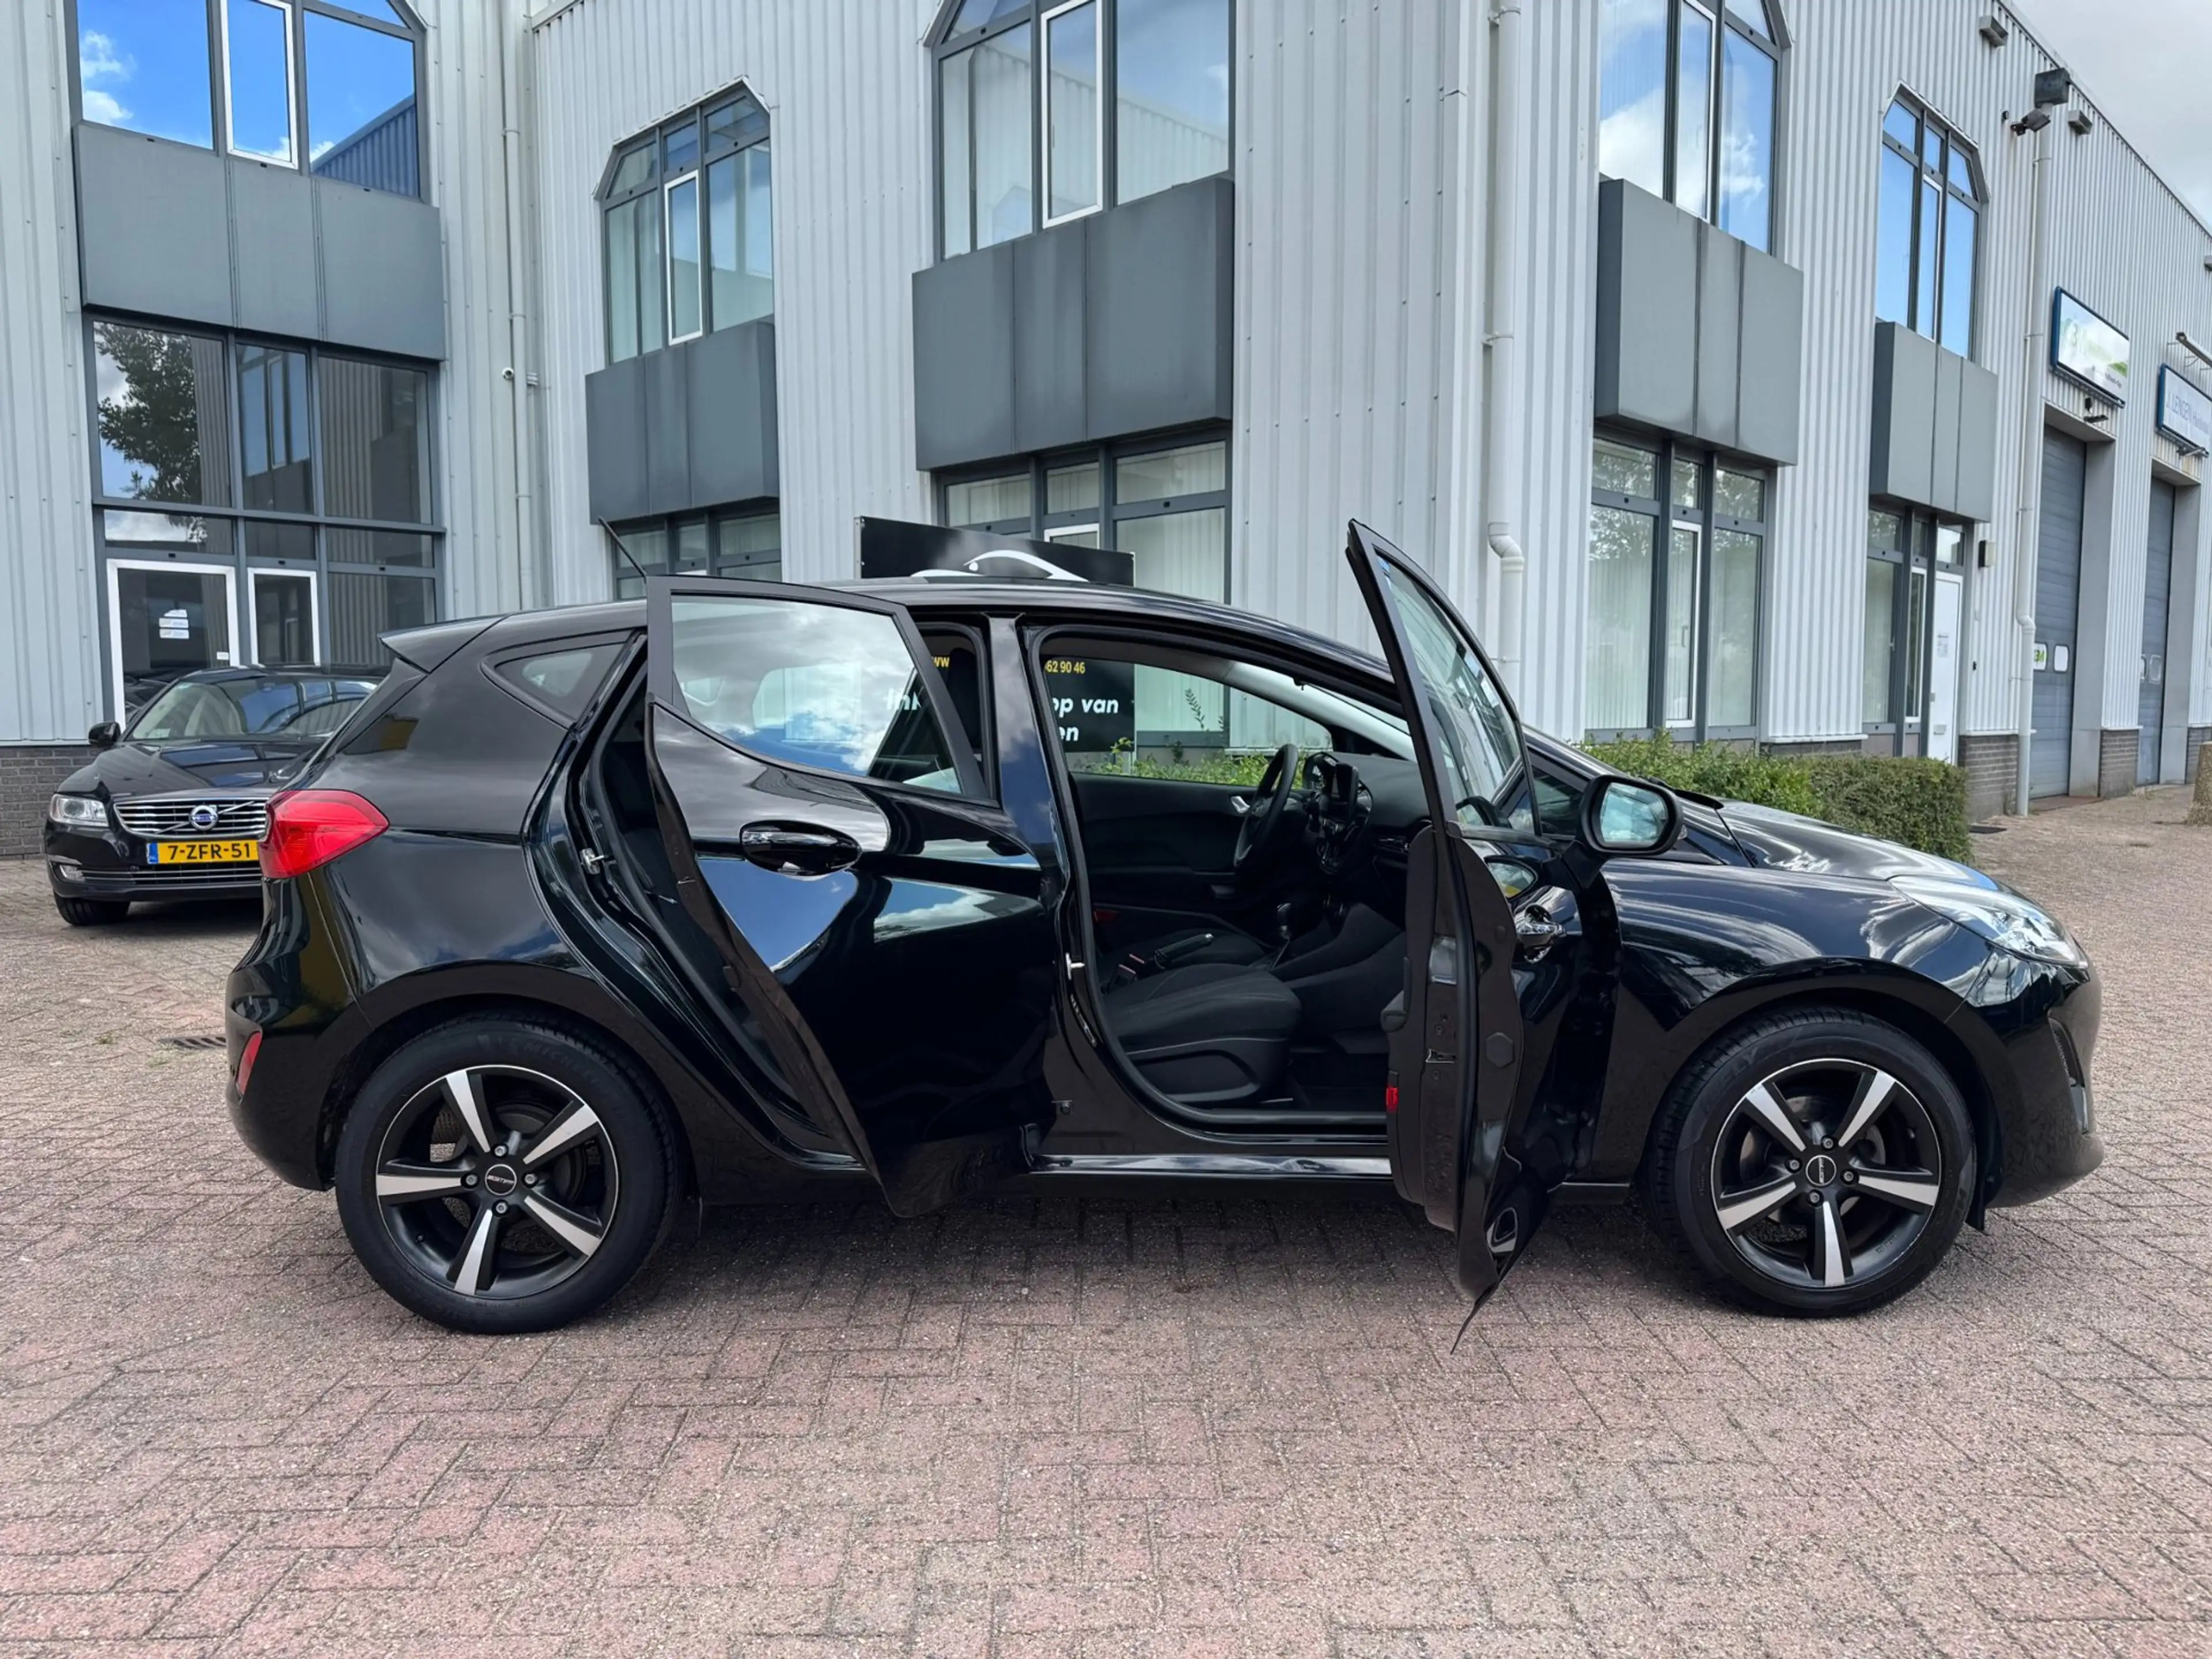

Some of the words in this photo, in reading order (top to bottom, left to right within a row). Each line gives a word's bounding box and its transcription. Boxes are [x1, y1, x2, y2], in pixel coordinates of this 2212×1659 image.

[1045, 660, 1058, 673] 62
[1060, 661, 1072, 673] 90
[1074, 662, 1086, 674] 46
[1081, 698, 1119, 714] van
[168, 843, 250, 860] 7-ZFR-51
